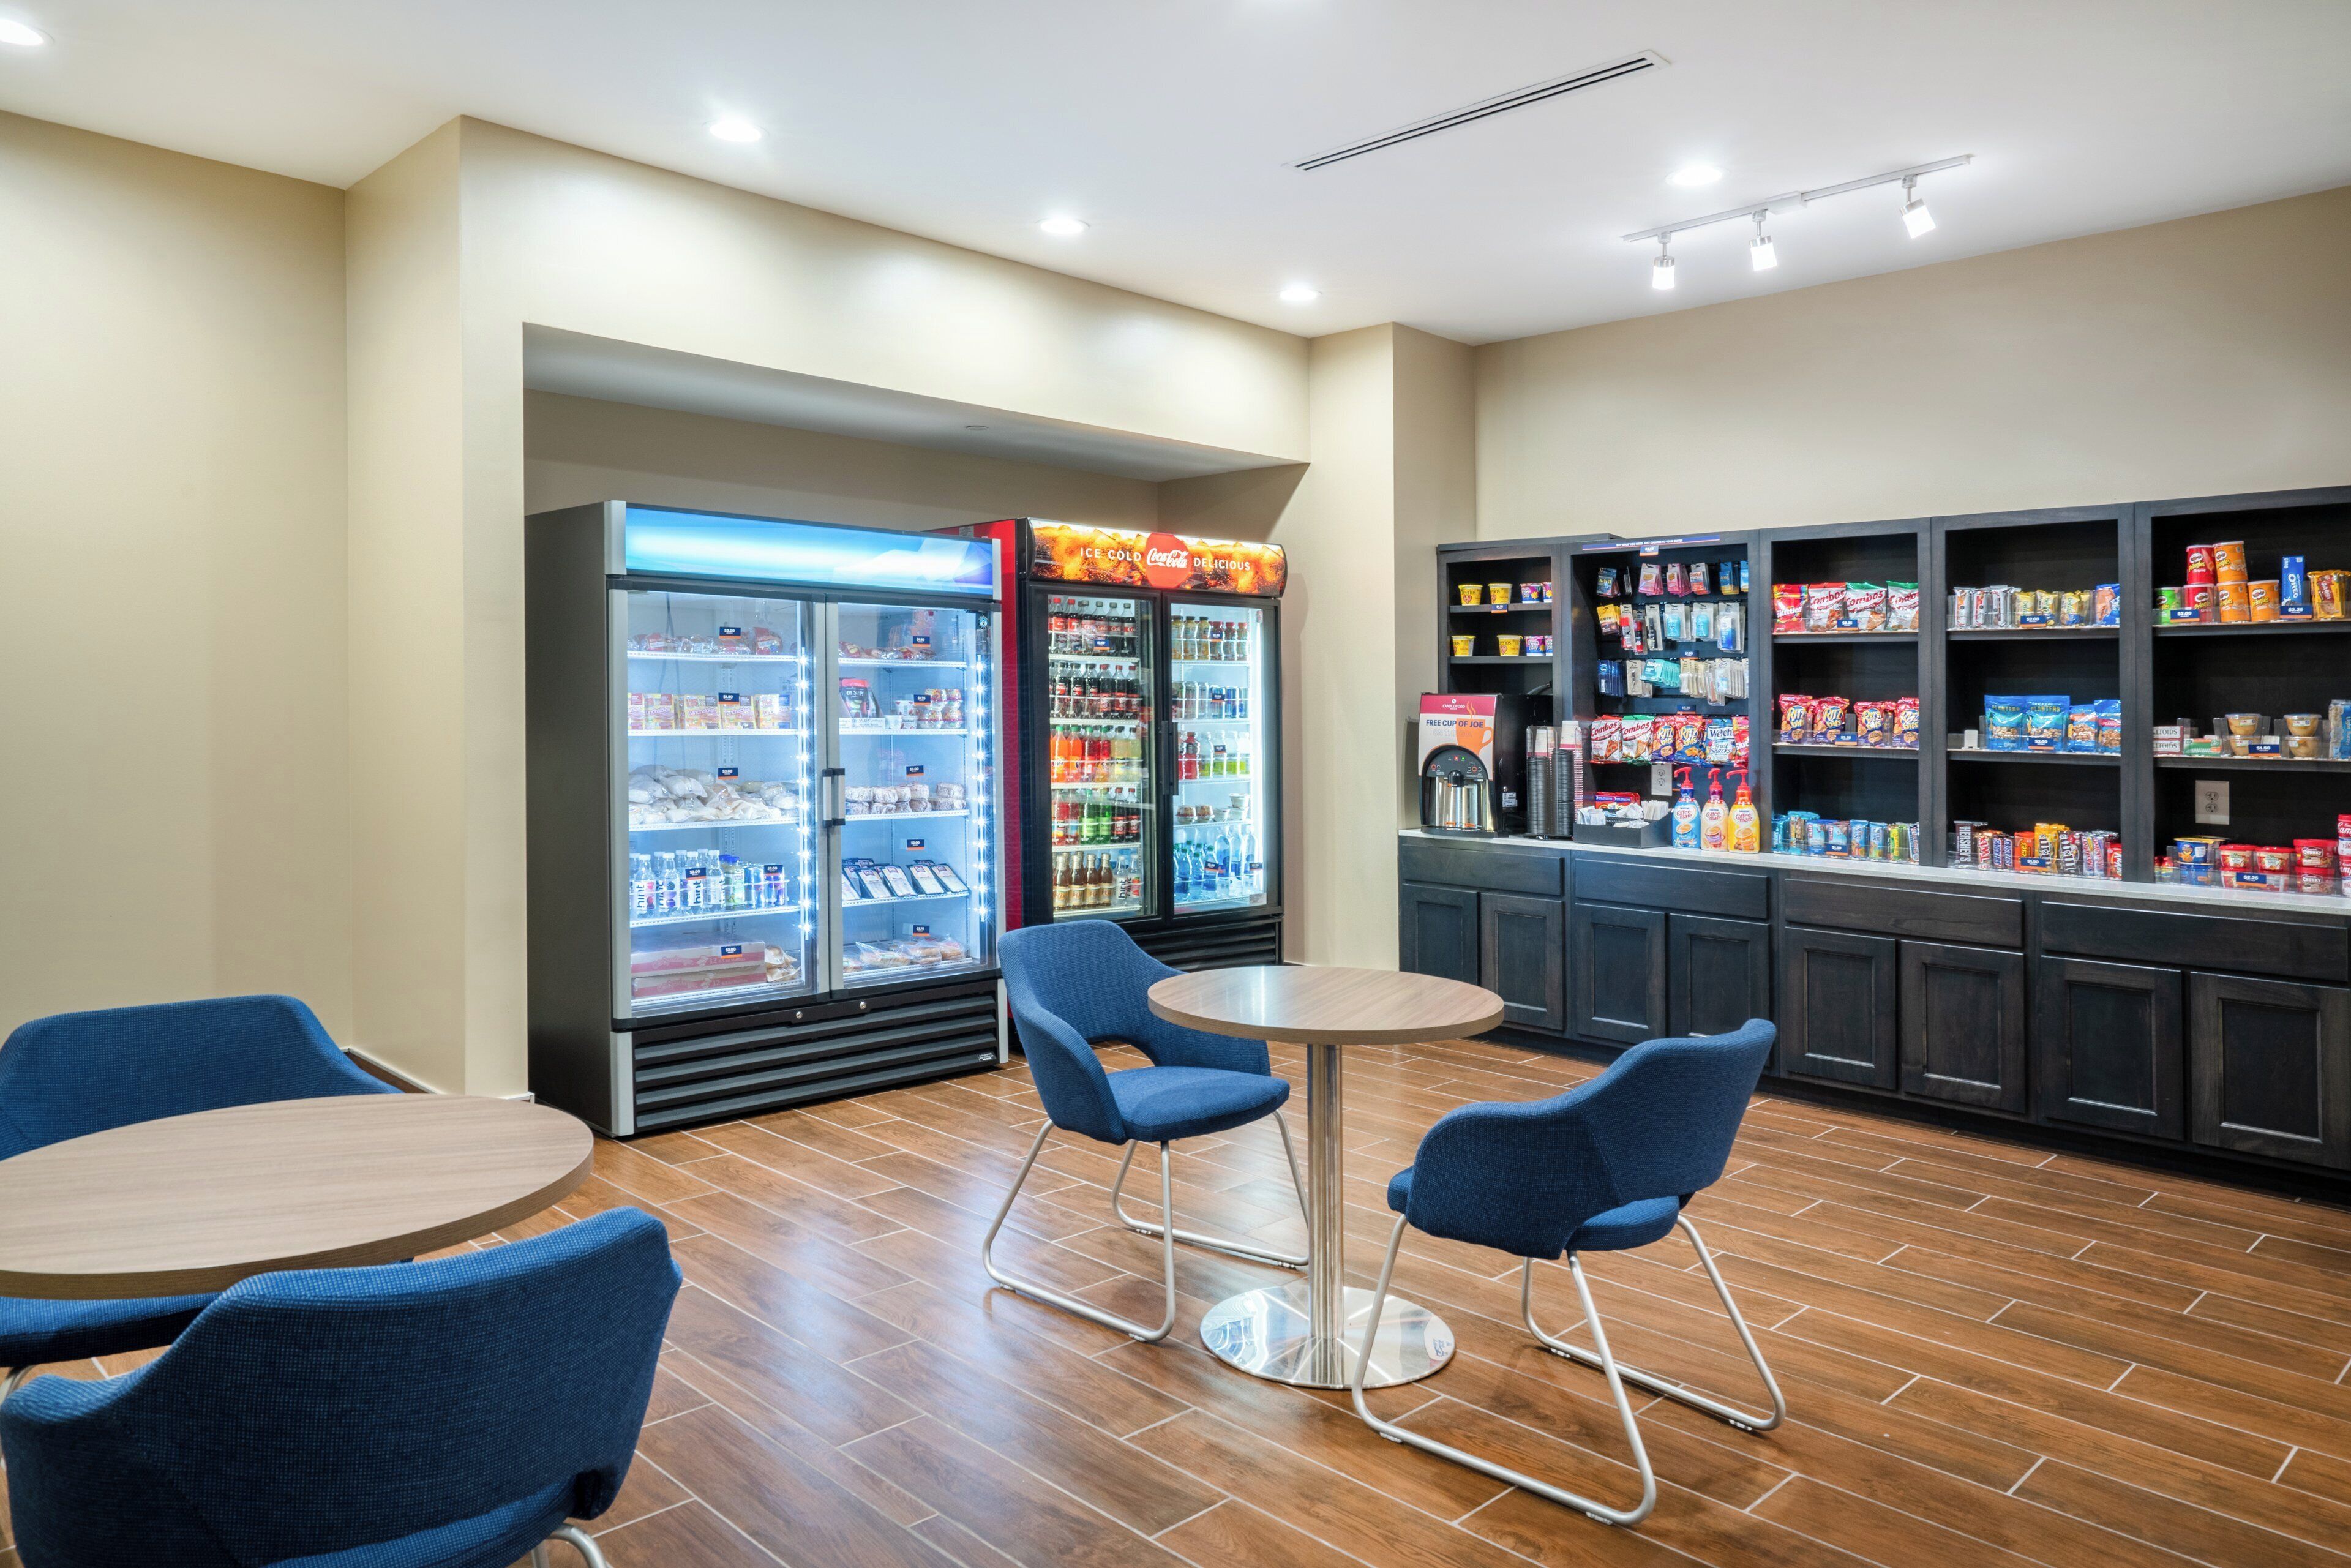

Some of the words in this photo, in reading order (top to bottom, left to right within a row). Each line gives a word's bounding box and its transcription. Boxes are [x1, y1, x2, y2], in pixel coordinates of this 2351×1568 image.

[1081, 547, 1101, 558] ICE
[1108, 549, 1141, 561] COLD
[1147, 547, 1189, 568] Coca-Cola
[1194, 557, 1250, 571] DELICIOUS
[2188, 561, 2205, 572] Pringles
[2288, 573, 2298, 598] OREO
[1810, 590, 1845, 606] Combos
[689, 705, 718, 716] Lunchables
[1823, 708, 1843, 721] RITZ
[1591, 721, 1618, 736] Combos
[1679, 726, 1698, 740] RITZ
[1959, 826, 1971, 862] HERSHEY'S
[636, 883, 645, 905] hint
[693, 880, 702, 904] hint
